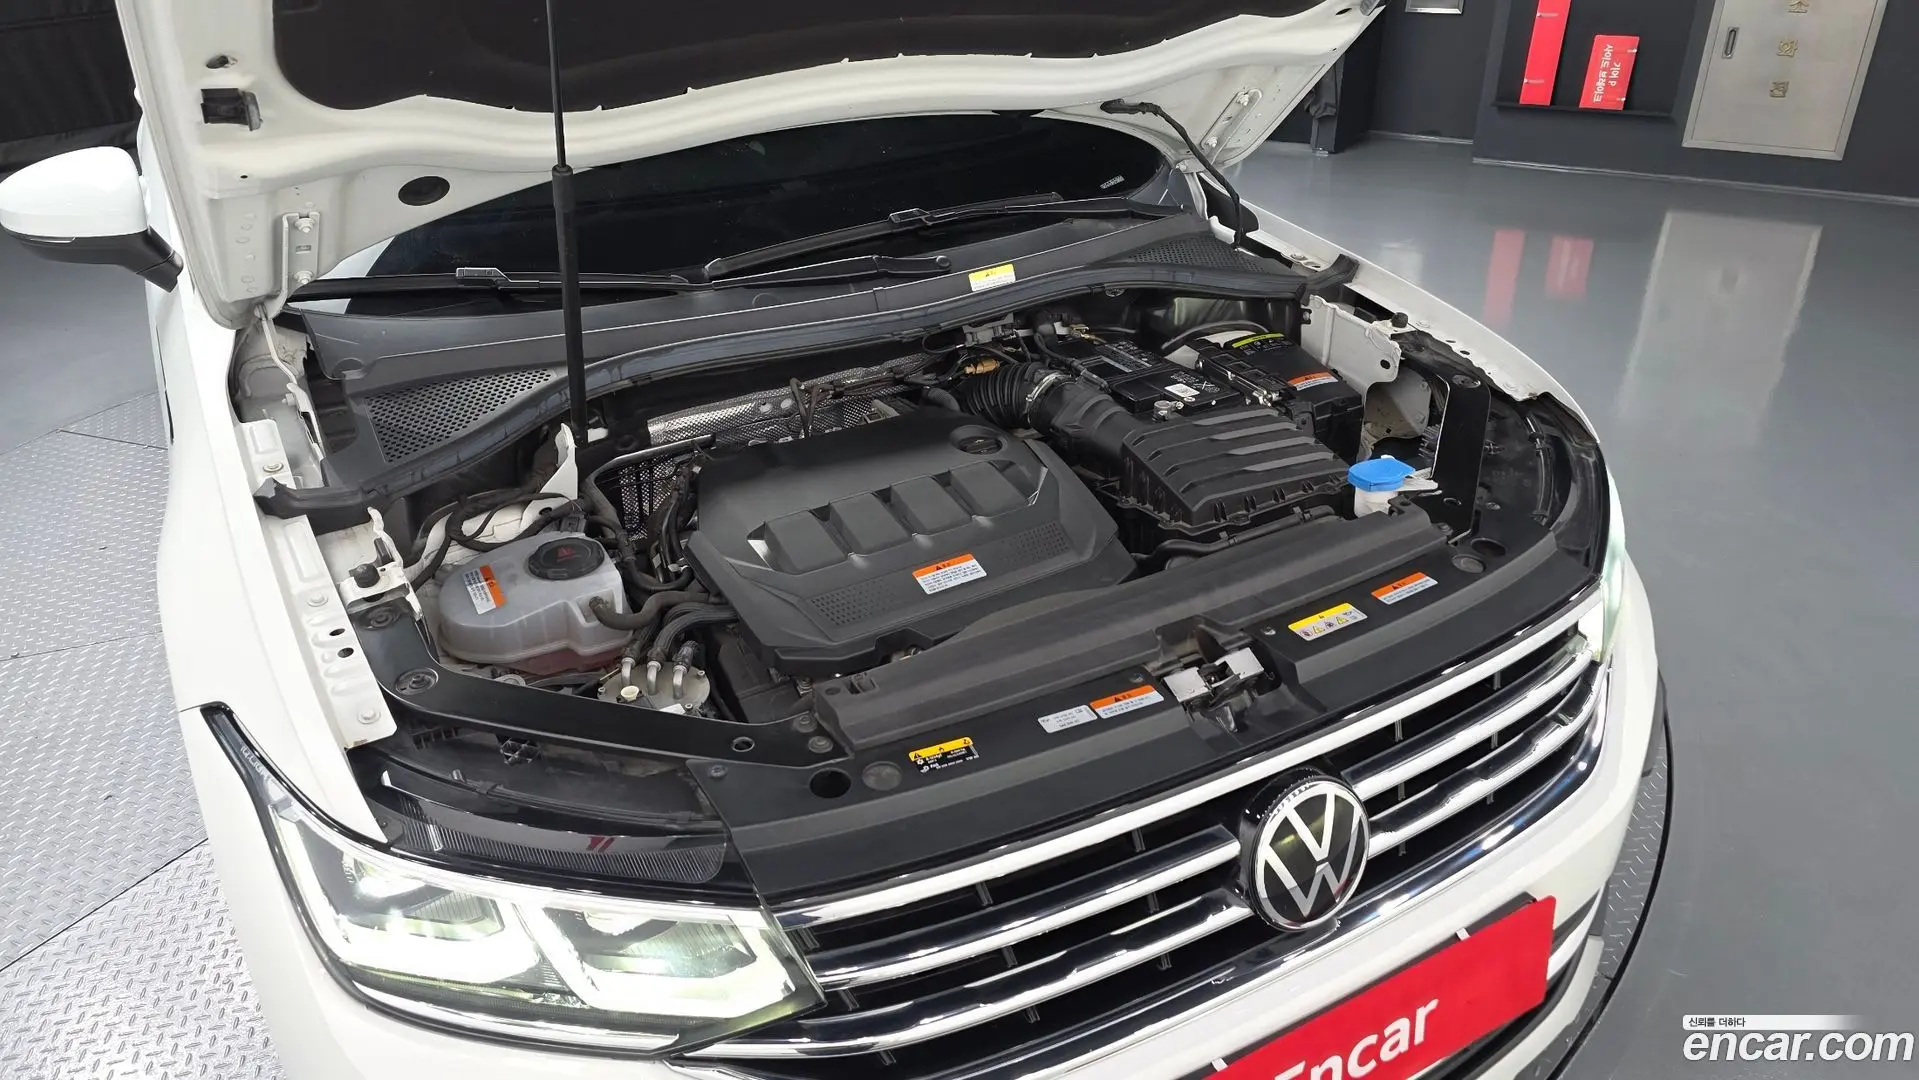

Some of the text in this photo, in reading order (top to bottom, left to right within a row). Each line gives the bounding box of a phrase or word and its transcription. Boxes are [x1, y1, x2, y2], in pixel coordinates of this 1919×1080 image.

[1593, 44, 1614, 103] 사이드 브레이크
[1609, 61, 1621, 78] 기어
